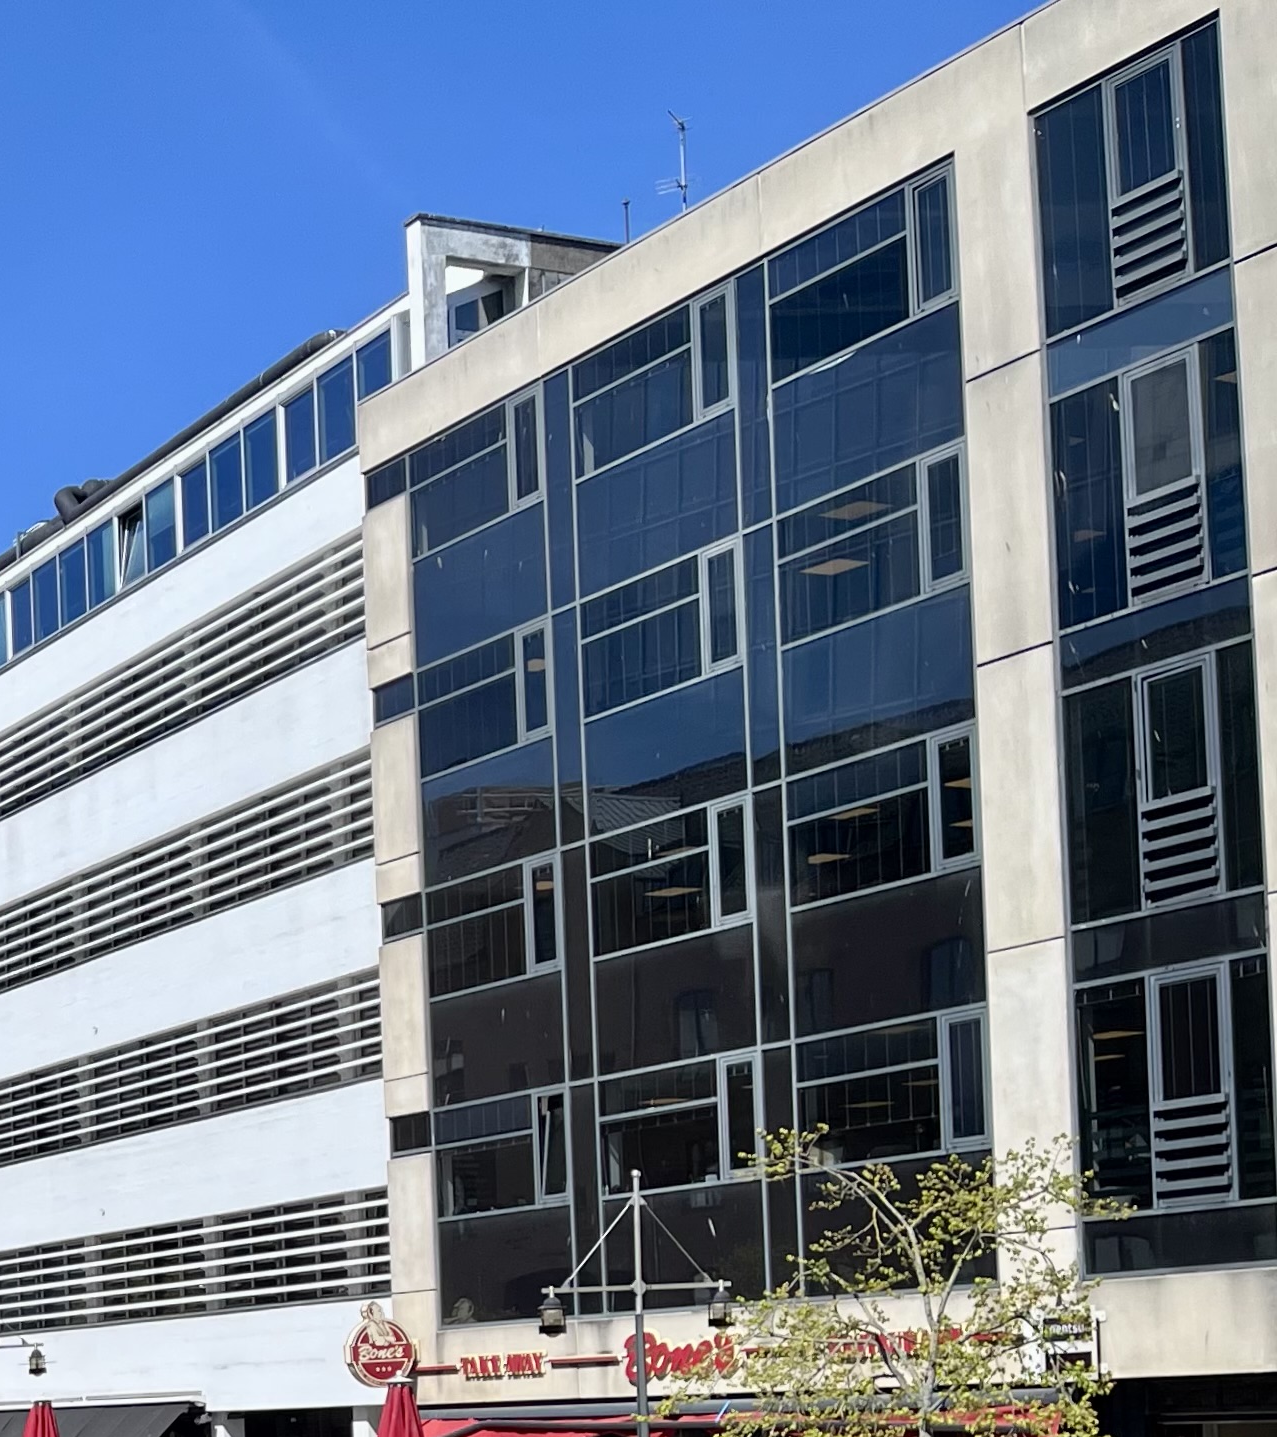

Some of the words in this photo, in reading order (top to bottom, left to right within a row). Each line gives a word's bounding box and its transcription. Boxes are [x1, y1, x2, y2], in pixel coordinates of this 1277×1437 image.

[357, 1343, 406, 1361] Bone's
[460, 1354, 505, 1381] TAKE
[505, 1350, 547, 1379] AWAY
